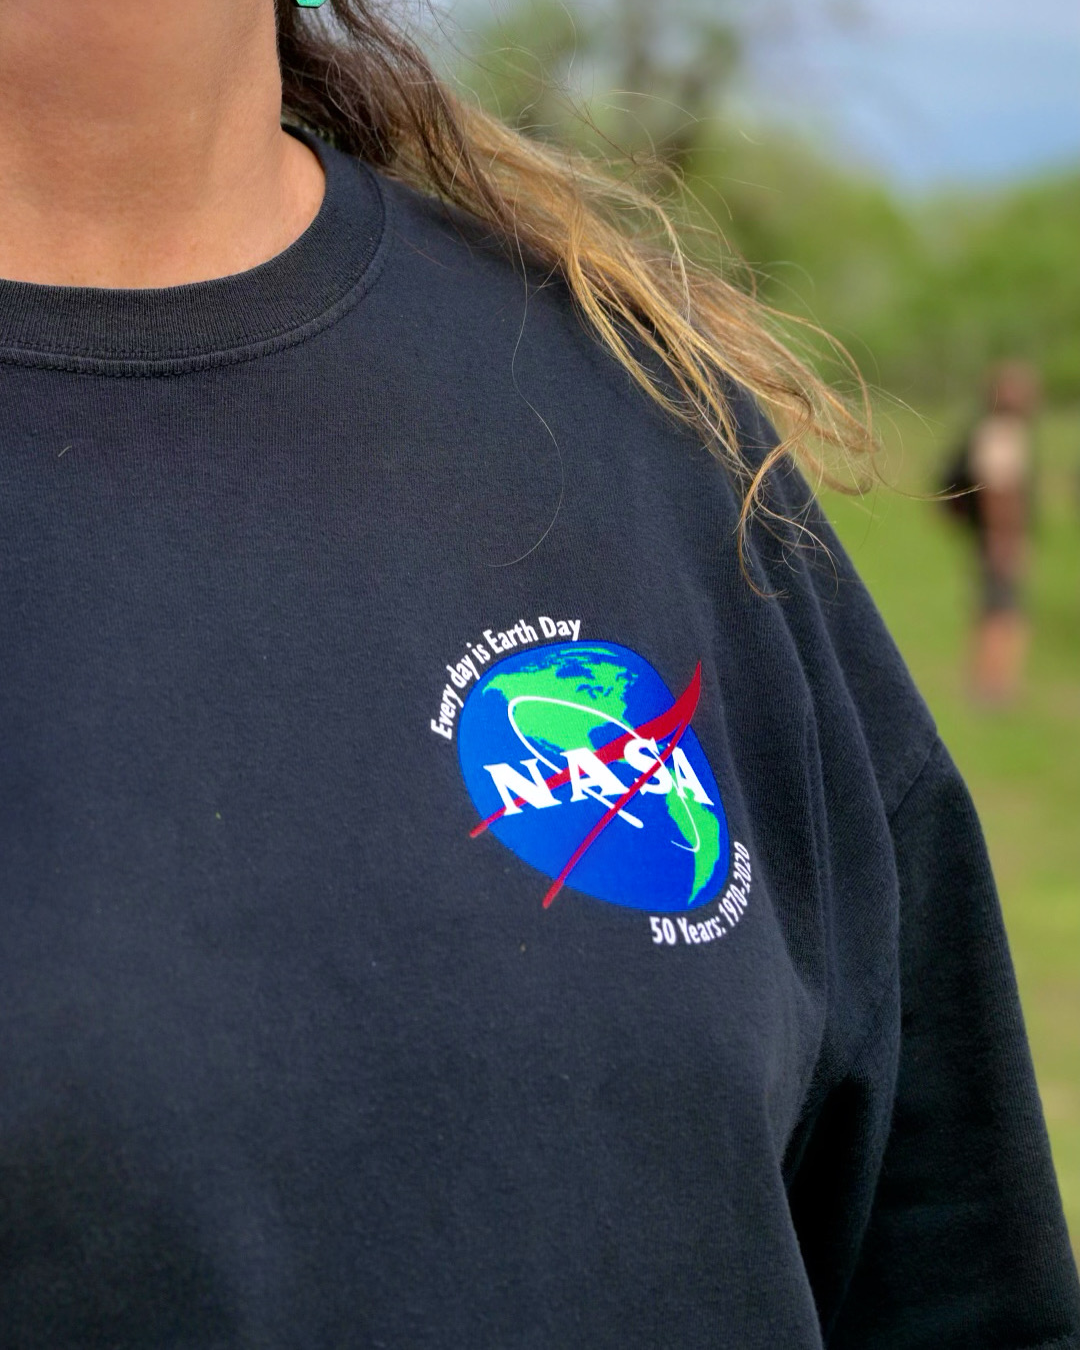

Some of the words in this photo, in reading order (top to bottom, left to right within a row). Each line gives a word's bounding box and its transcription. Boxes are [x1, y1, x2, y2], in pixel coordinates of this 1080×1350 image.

[482, 618, 538, 654] Earth
[538, 615, 582, 642] Day
[466, 642, 491, 664] is
[446, 654, 481, 689] day
[430, 683, 465, 741] Every
[483, 736, 715, 817] NASA
[649, 915, 677, 946] 50
[676, 915, 727, 946] Years:
[718, 840, 752, 928] 1970-2020
